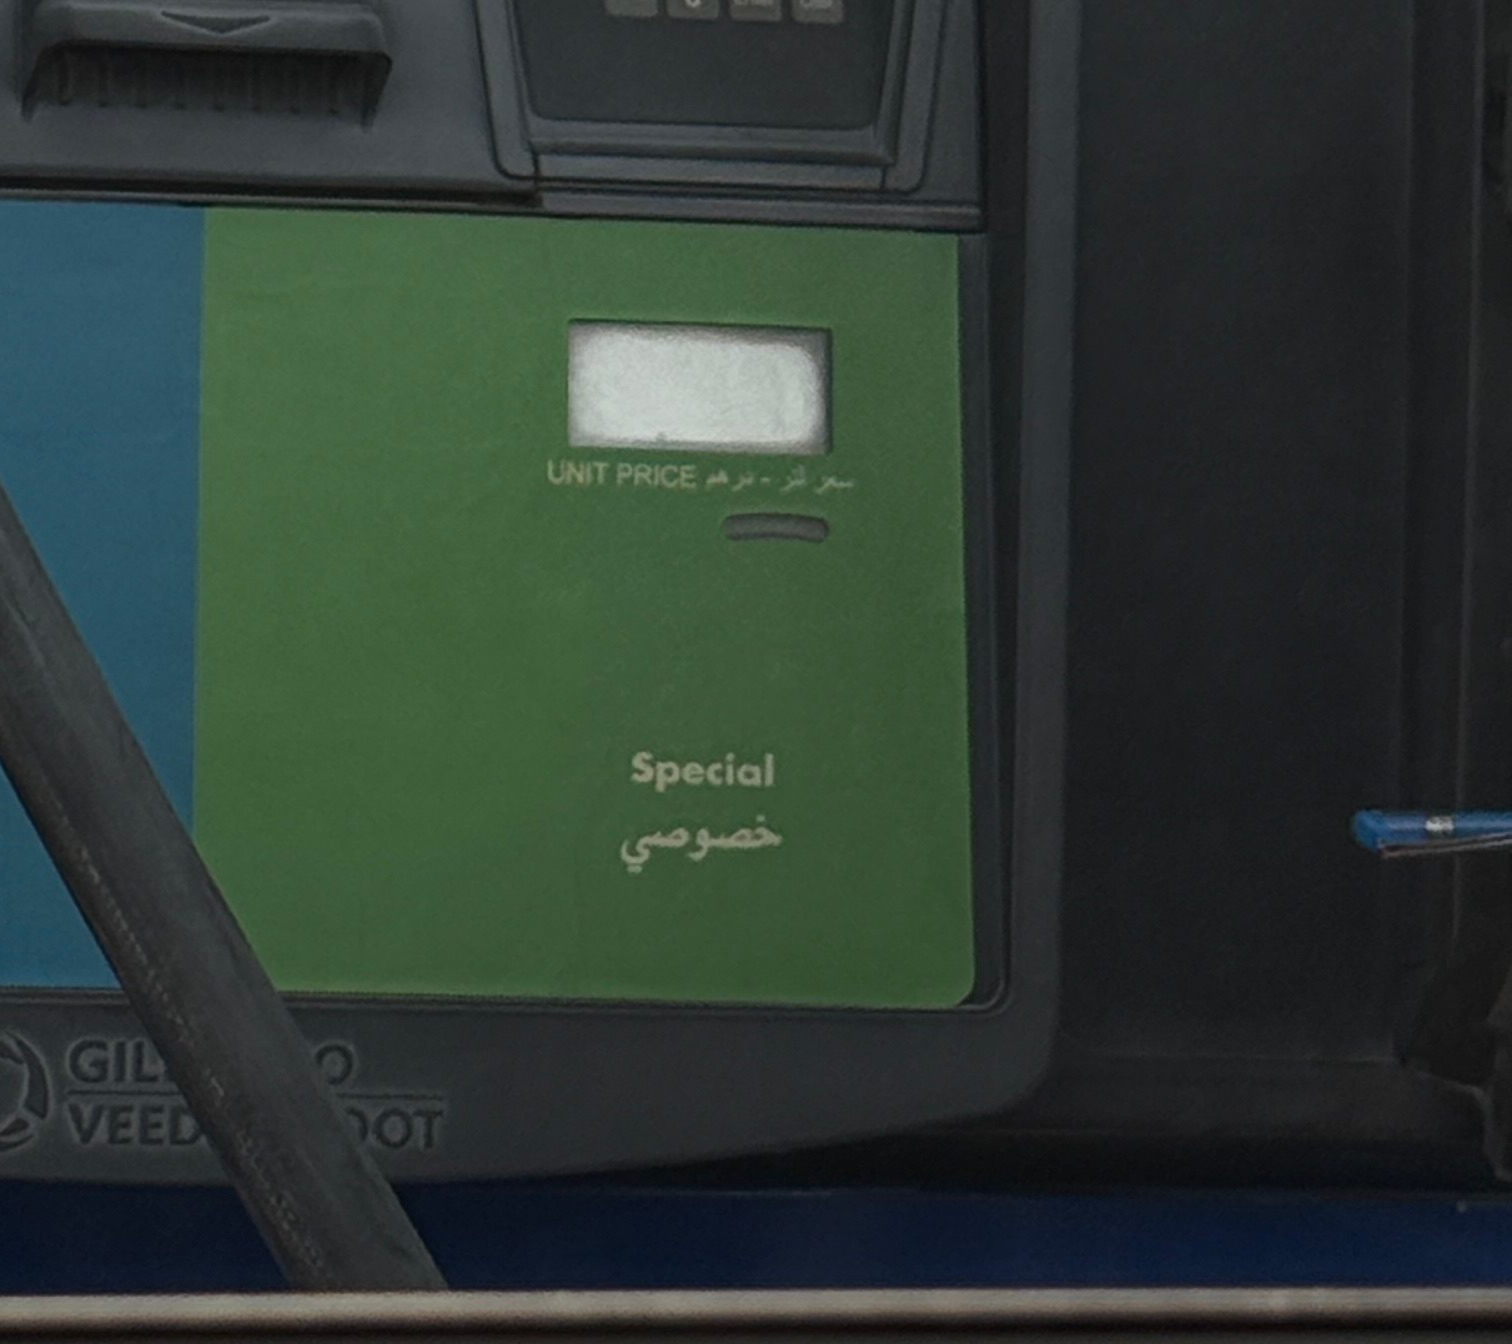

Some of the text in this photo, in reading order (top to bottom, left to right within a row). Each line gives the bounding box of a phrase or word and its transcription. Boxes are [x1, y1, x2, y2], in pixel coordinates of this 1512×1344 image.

[547, 459, 698, 489] UNIT PRICE
[630, 751, 776, 793] Special
[620, 814, 783, 873] خصوصي
